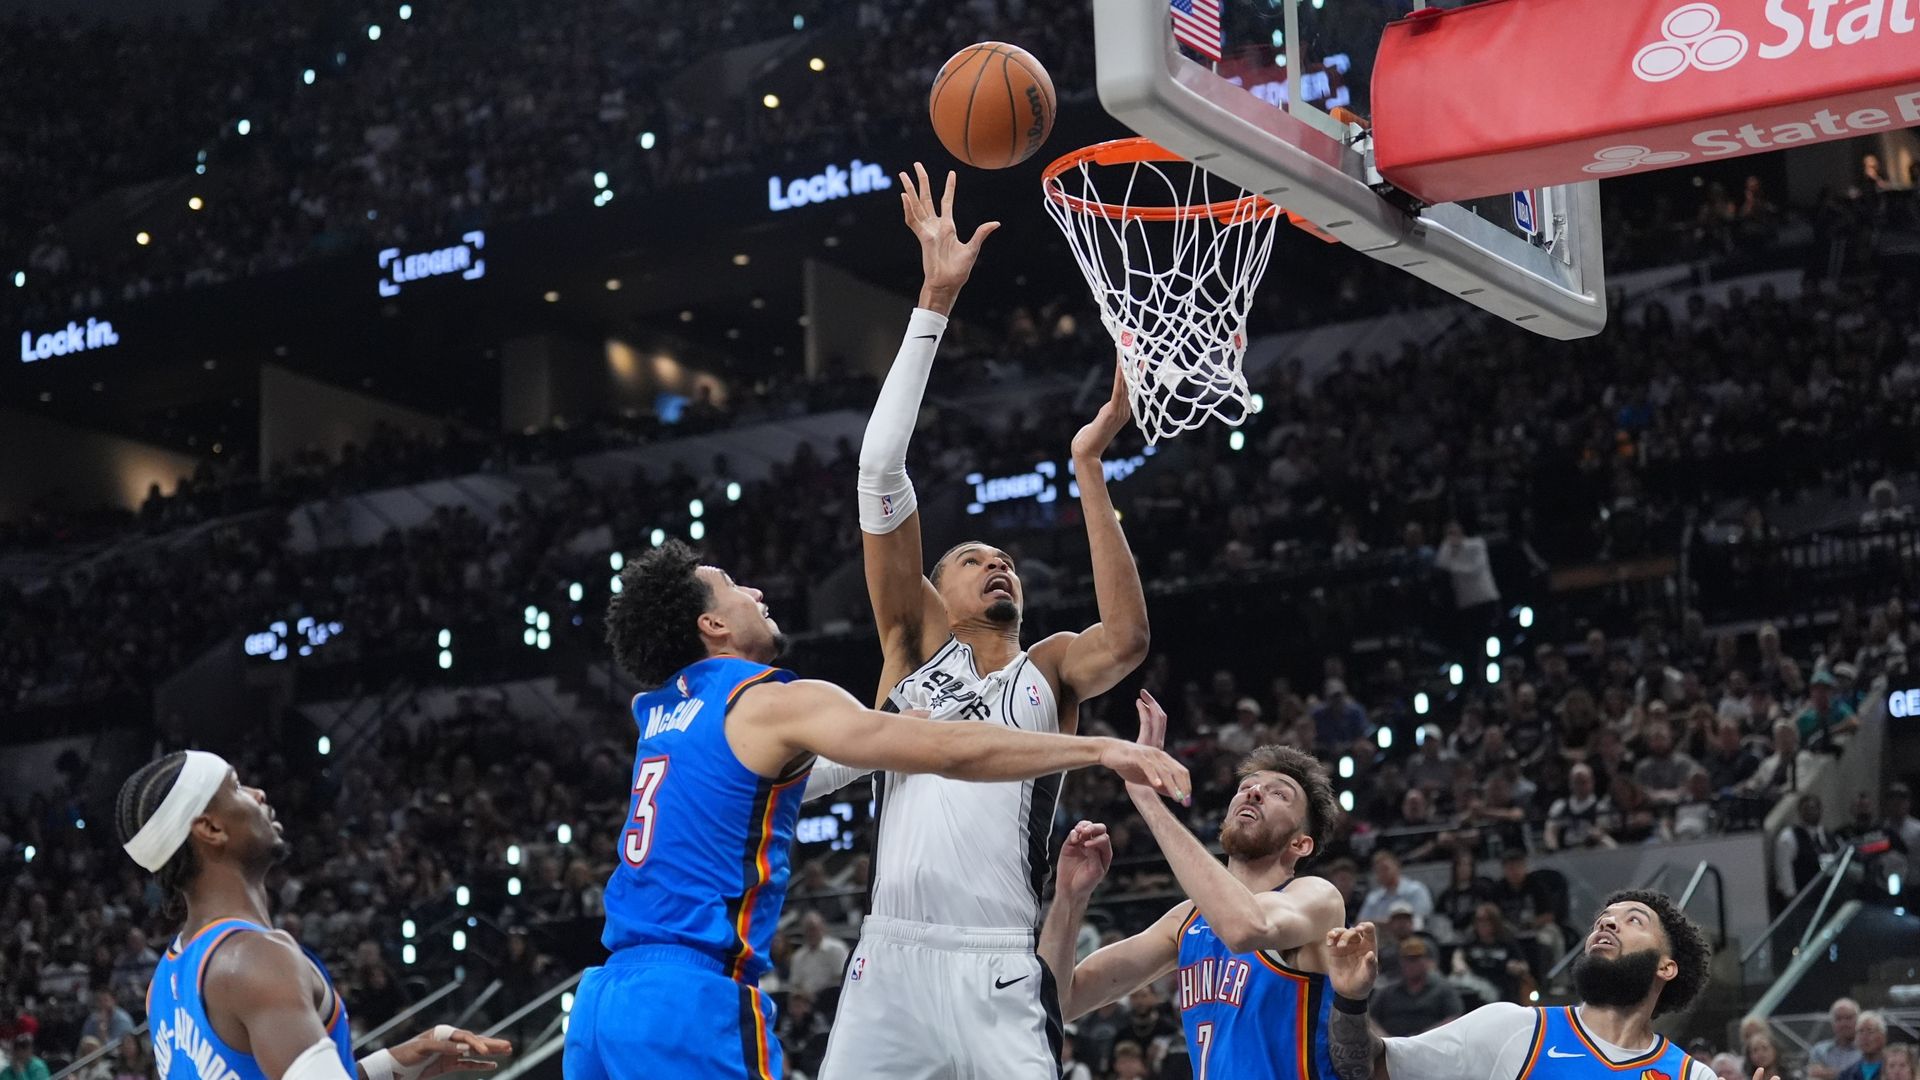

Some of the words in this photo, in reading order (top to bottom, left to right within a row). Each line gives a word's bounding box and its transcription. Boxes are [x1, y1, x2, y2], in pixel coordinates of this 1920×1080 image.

[1758, 0, 1920, 59] Stat
[1692, 108, 1890, 156] State
[768, 164, 849, 211] Lock
[850, 159, 891, 195] in.
[393, 246, 470, 282] LEDGER
[21, 321, 85, 363] Lock
[86, 316, 119, 349] in.
[975, 472, 1044, 504] LEDGER
[624, 755, 669, 868] 3
[1197, 1022, 1213, 1080] 7
